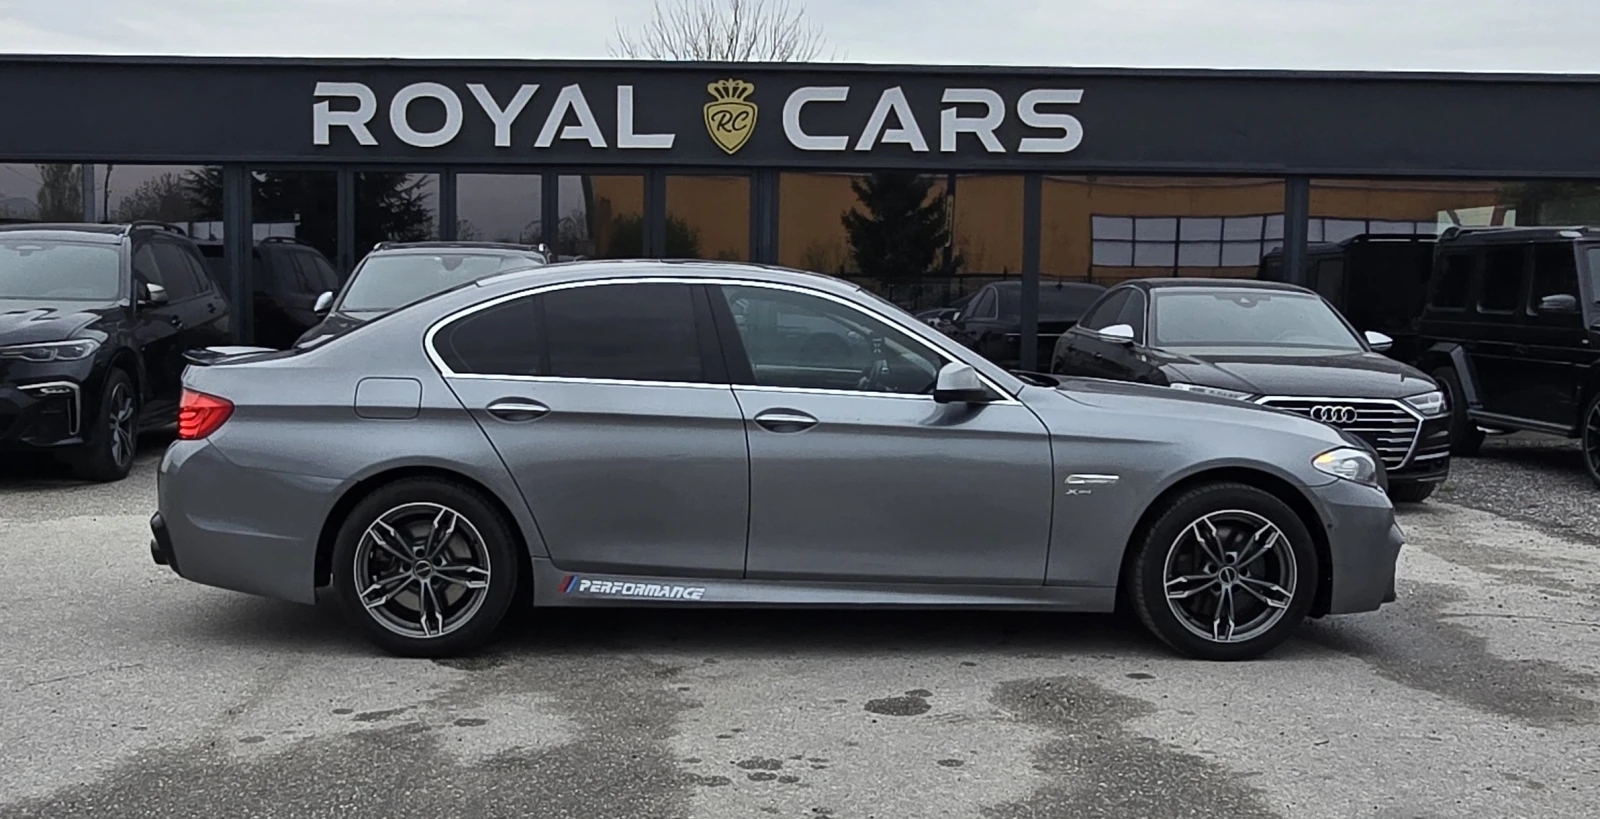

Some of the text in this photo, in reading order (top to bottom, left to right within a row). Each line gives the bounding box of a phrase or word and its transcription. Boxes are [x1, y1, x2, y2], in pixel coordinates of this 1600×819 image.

[312, 81, 1085, 153] ROYAL CARS
[711, 110, 749, 133] RC
[579, 579, 706, 600] PERFORMANCE
